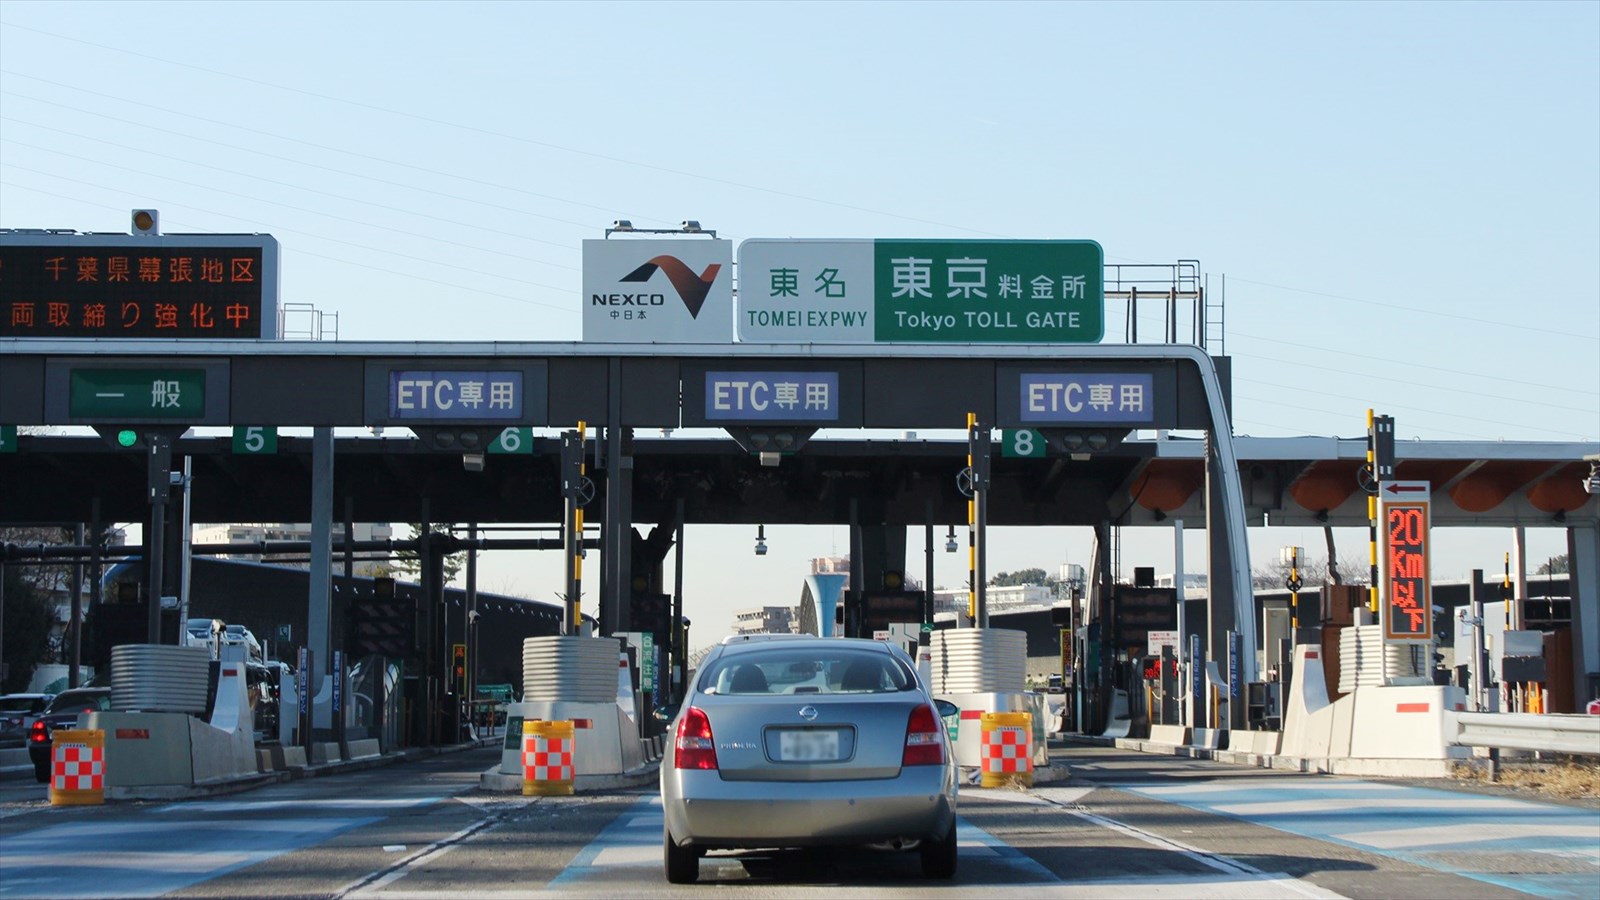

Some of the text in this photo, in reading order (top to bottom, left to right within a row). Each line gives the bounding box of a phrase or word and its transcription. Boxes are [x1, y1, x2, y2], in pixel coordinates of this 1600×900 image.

[45, 257, 254, 282] 千葉県幕張地区
[769, 268, 846, 298] 東名
[592, 294, 664, 305] NEXCO
[12, 303, 249, 328] 両取締り強化中
[610, 310, 647, 320] 中日本
[747, 310, 868, 327] TOMEI EXPWY
[894, 311, 1080, 331] Tokyo TOLL GATE
[96, 380, 181, 408] 一般
[245, 426, 265, 451] 5
[500, 427, 521, 451] 6
[1014, 429, 1034, 456] 8
[1389, 509, 1424, 545] 20
[1391, 580, 1424, 632] 以下
[643, 636, 653, 688] 合流注意
